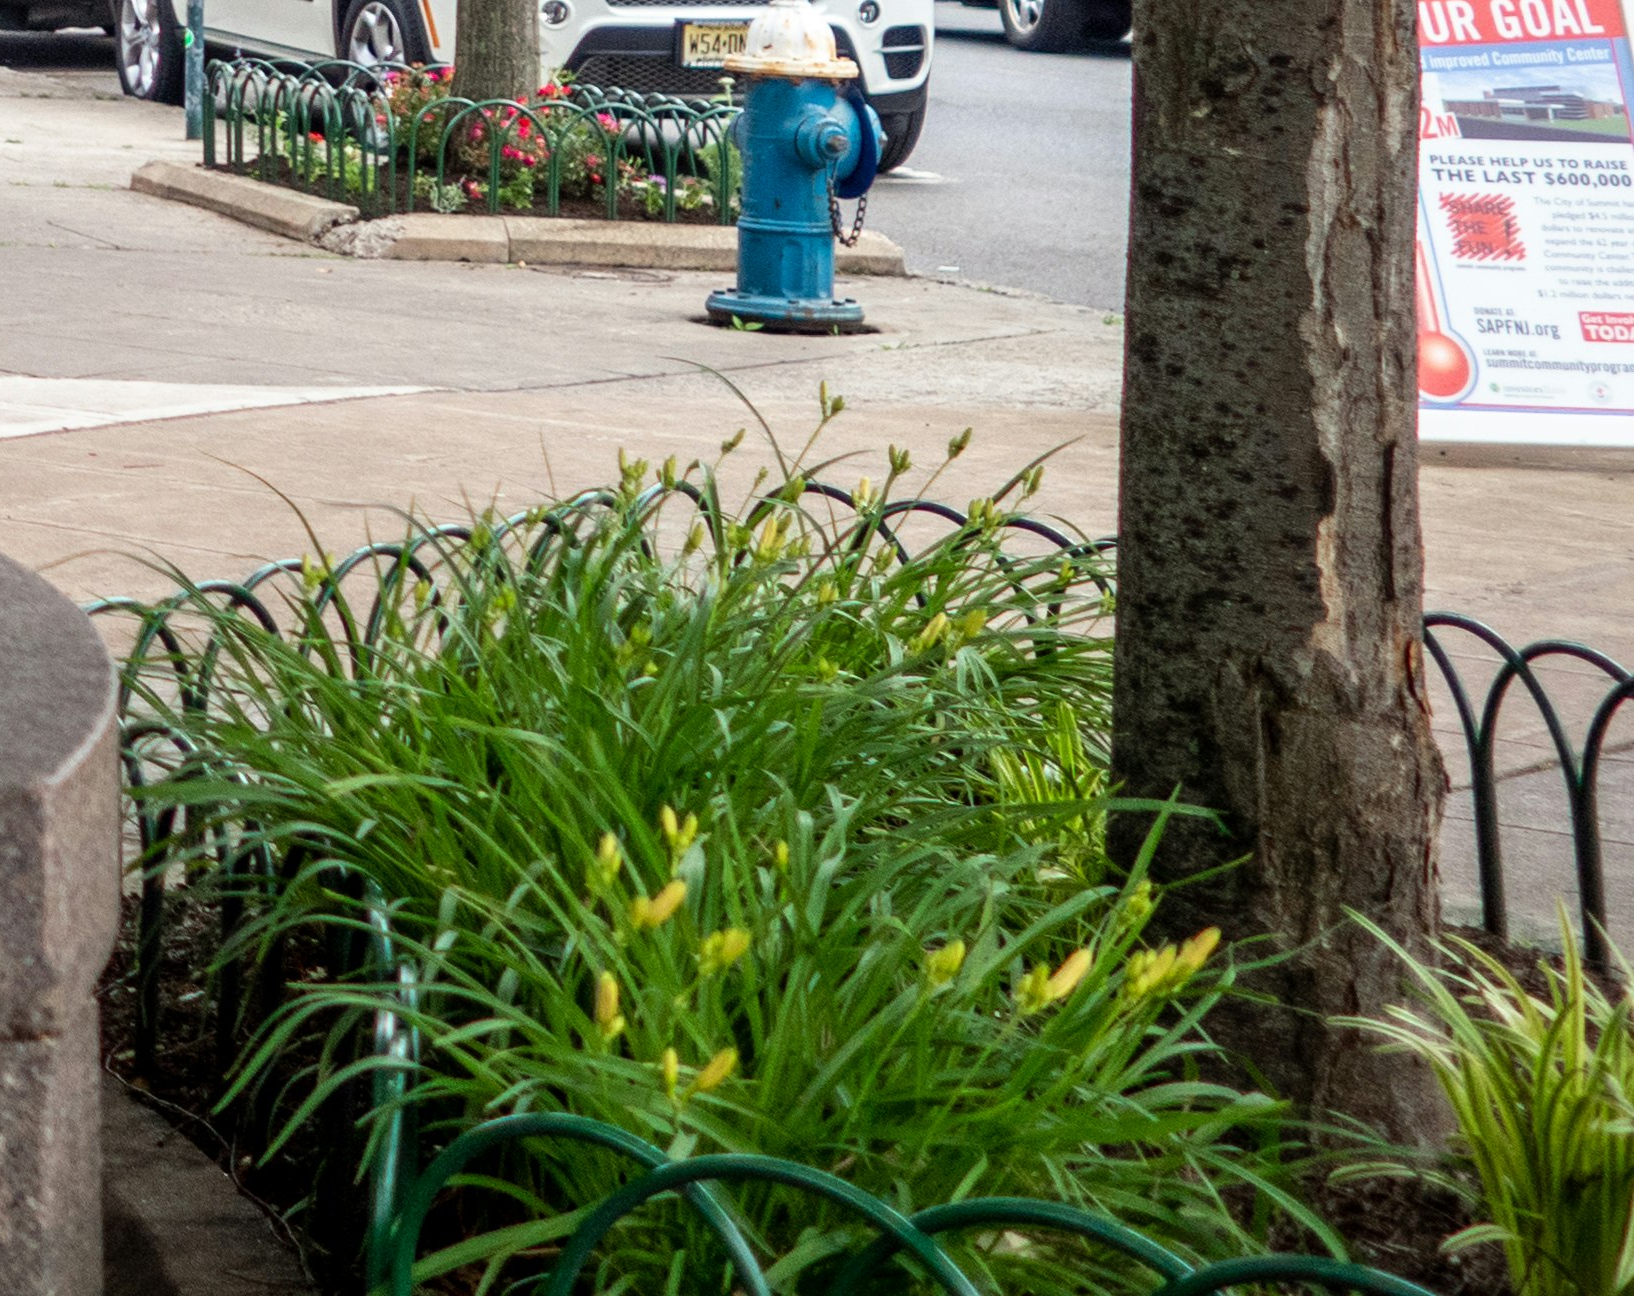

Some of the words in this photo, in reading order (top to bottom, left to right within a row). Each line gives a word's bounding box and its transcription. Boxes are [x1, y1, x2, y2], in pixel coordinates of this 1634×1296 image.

[1419, 0, 1483, 43] UR
[1492, 48, 1564, 65] Community
[1567, 47, 1611, 61] Center
[1429, 154, 1485, 166] PLEASE
[1489, 156, 1529, 167] HELP
[1533, 158, 1553, 168] US
[1557, 158, 1579, 168] TO
[1584, 159, 1628, 170] RAISE
[1431, 168, 1476, 182] THE
[1483, 170, 1536, 184] LAST
[1544, 172, 1633, 188] $600,000
[1477, 318, 1561, 340] SAPFNJ.org
